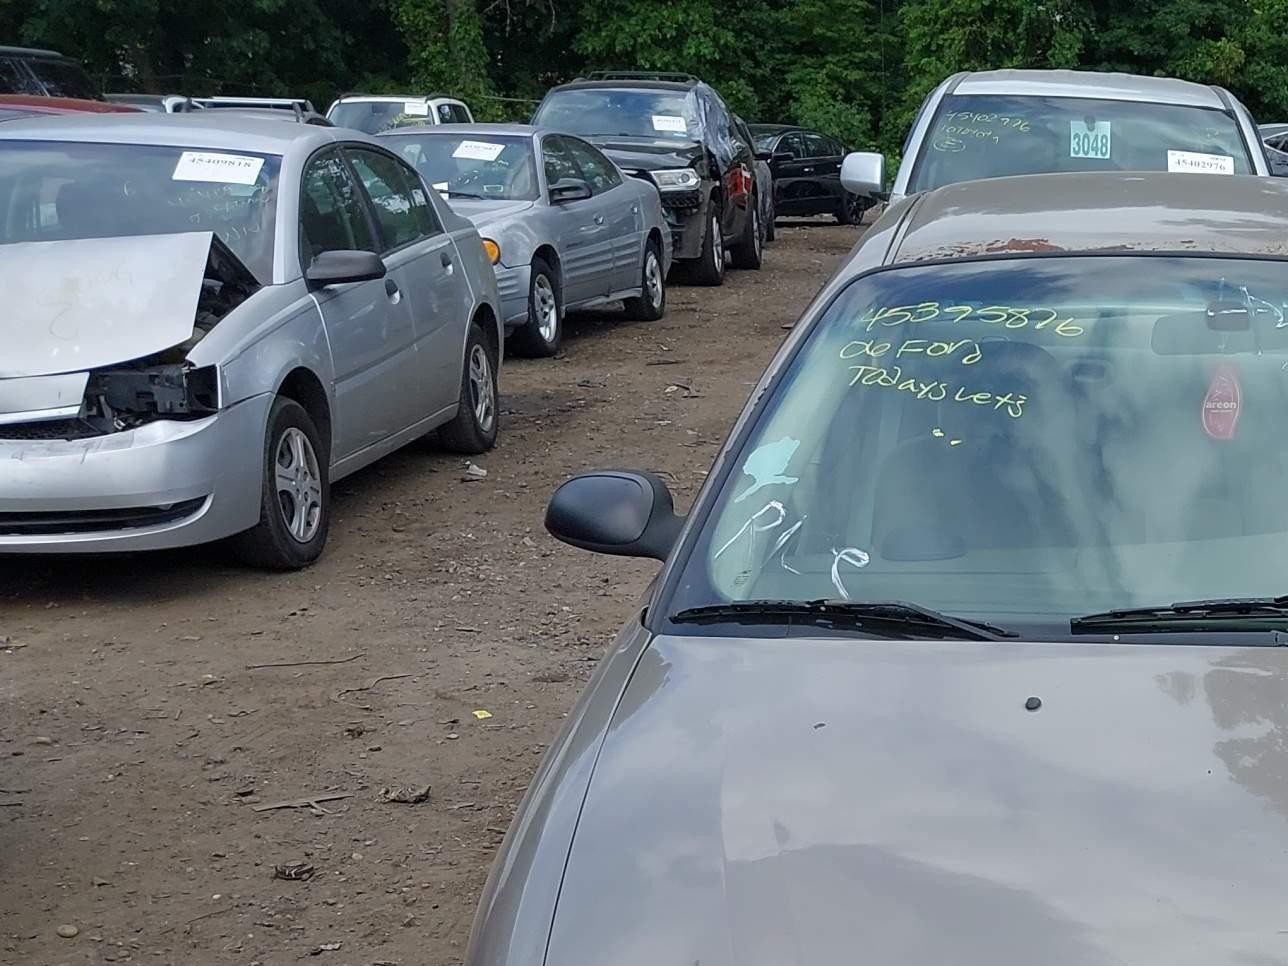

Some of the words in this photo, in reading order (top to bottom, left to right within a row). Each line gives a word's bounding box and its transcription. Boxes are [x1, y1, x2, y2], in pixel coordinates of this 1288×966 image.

[1072, 132, 1109, 157] 3048
[1175, 158, 1226, 171] 45402976
[896, 339, 983, 365] Ford
